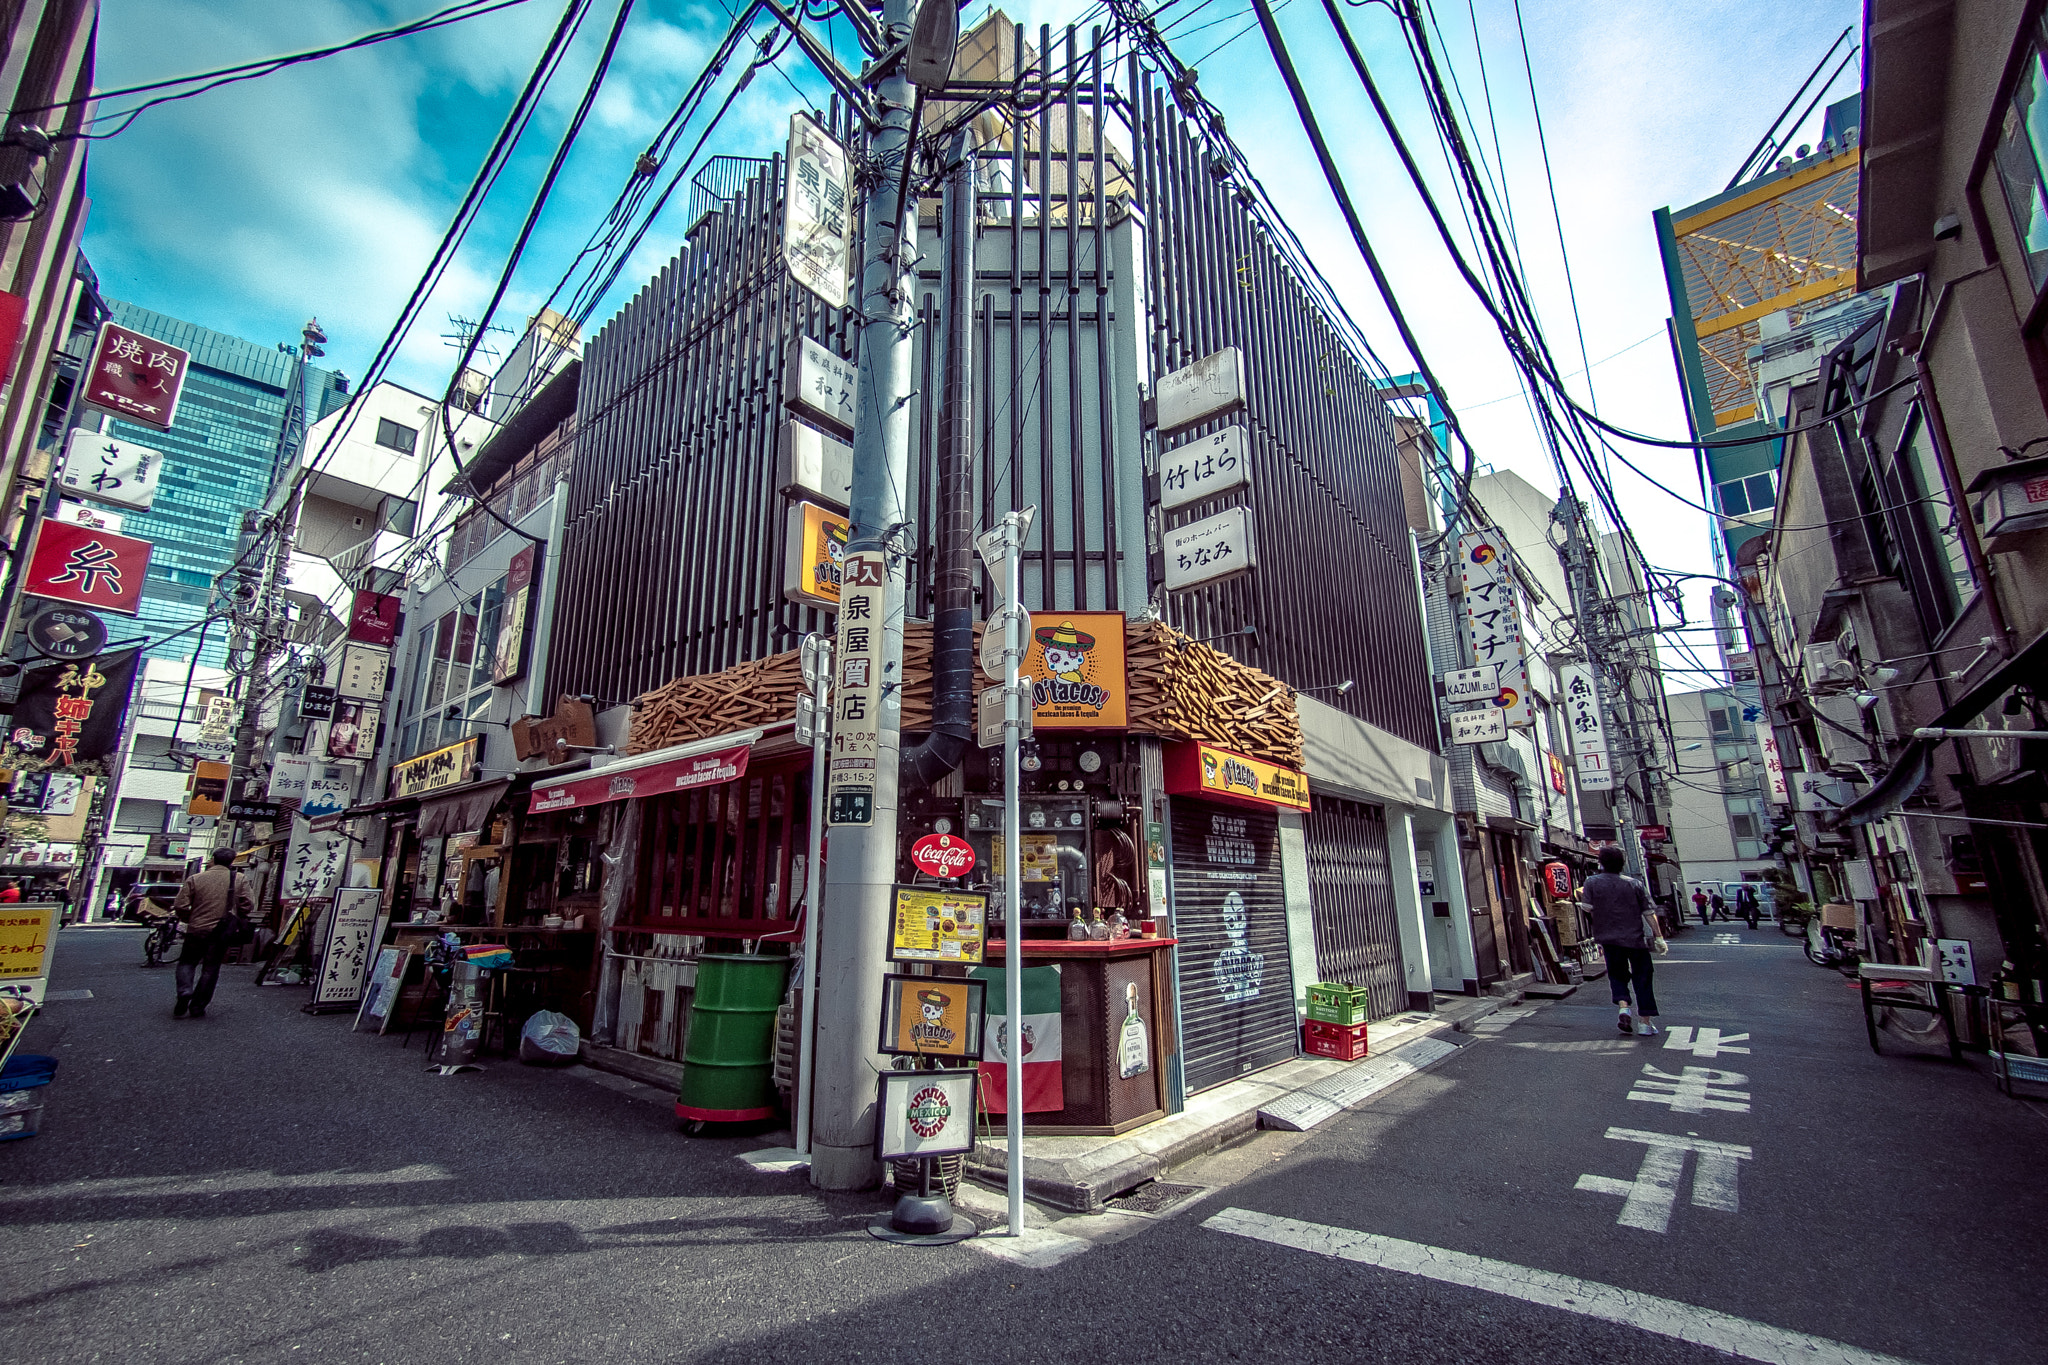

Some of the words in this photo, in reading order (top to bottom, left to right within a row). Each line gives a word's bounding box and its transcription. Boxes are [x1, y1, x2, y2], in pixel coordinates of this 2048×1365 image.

[108, 334, 179, 377] 焼肉
[1213, 433, 1228, 446] 2F
[91, 443, 123, 492] さわ
[1162, 447, 1237, 491] 竹はら
[1176, 540, 1233, 572] ちなみ
[844, 559, 879, 584] 買入
[842, 594, 871, 721] 泉屋質店
[1568, 675, 1598, 734] 魚の家
[846, 732, 876, 742] この次
[1457, 722, 1501, 738] 和久井
[848, 742, 872, 752] 左へ
[834, 796, 865, 808] 新橋
[834, 810, 863, 821] 3-14
[322, 839, 340, 889] いきなり
[918, 844, 970, 867] Coca-Cola
[1552, 867, 1569, 894] 酒処
[327, 935, 348, 982] ステーキ
[351, 930, 369, 981] いきなり
[910, 1107, 948, 1118] MEXICO
